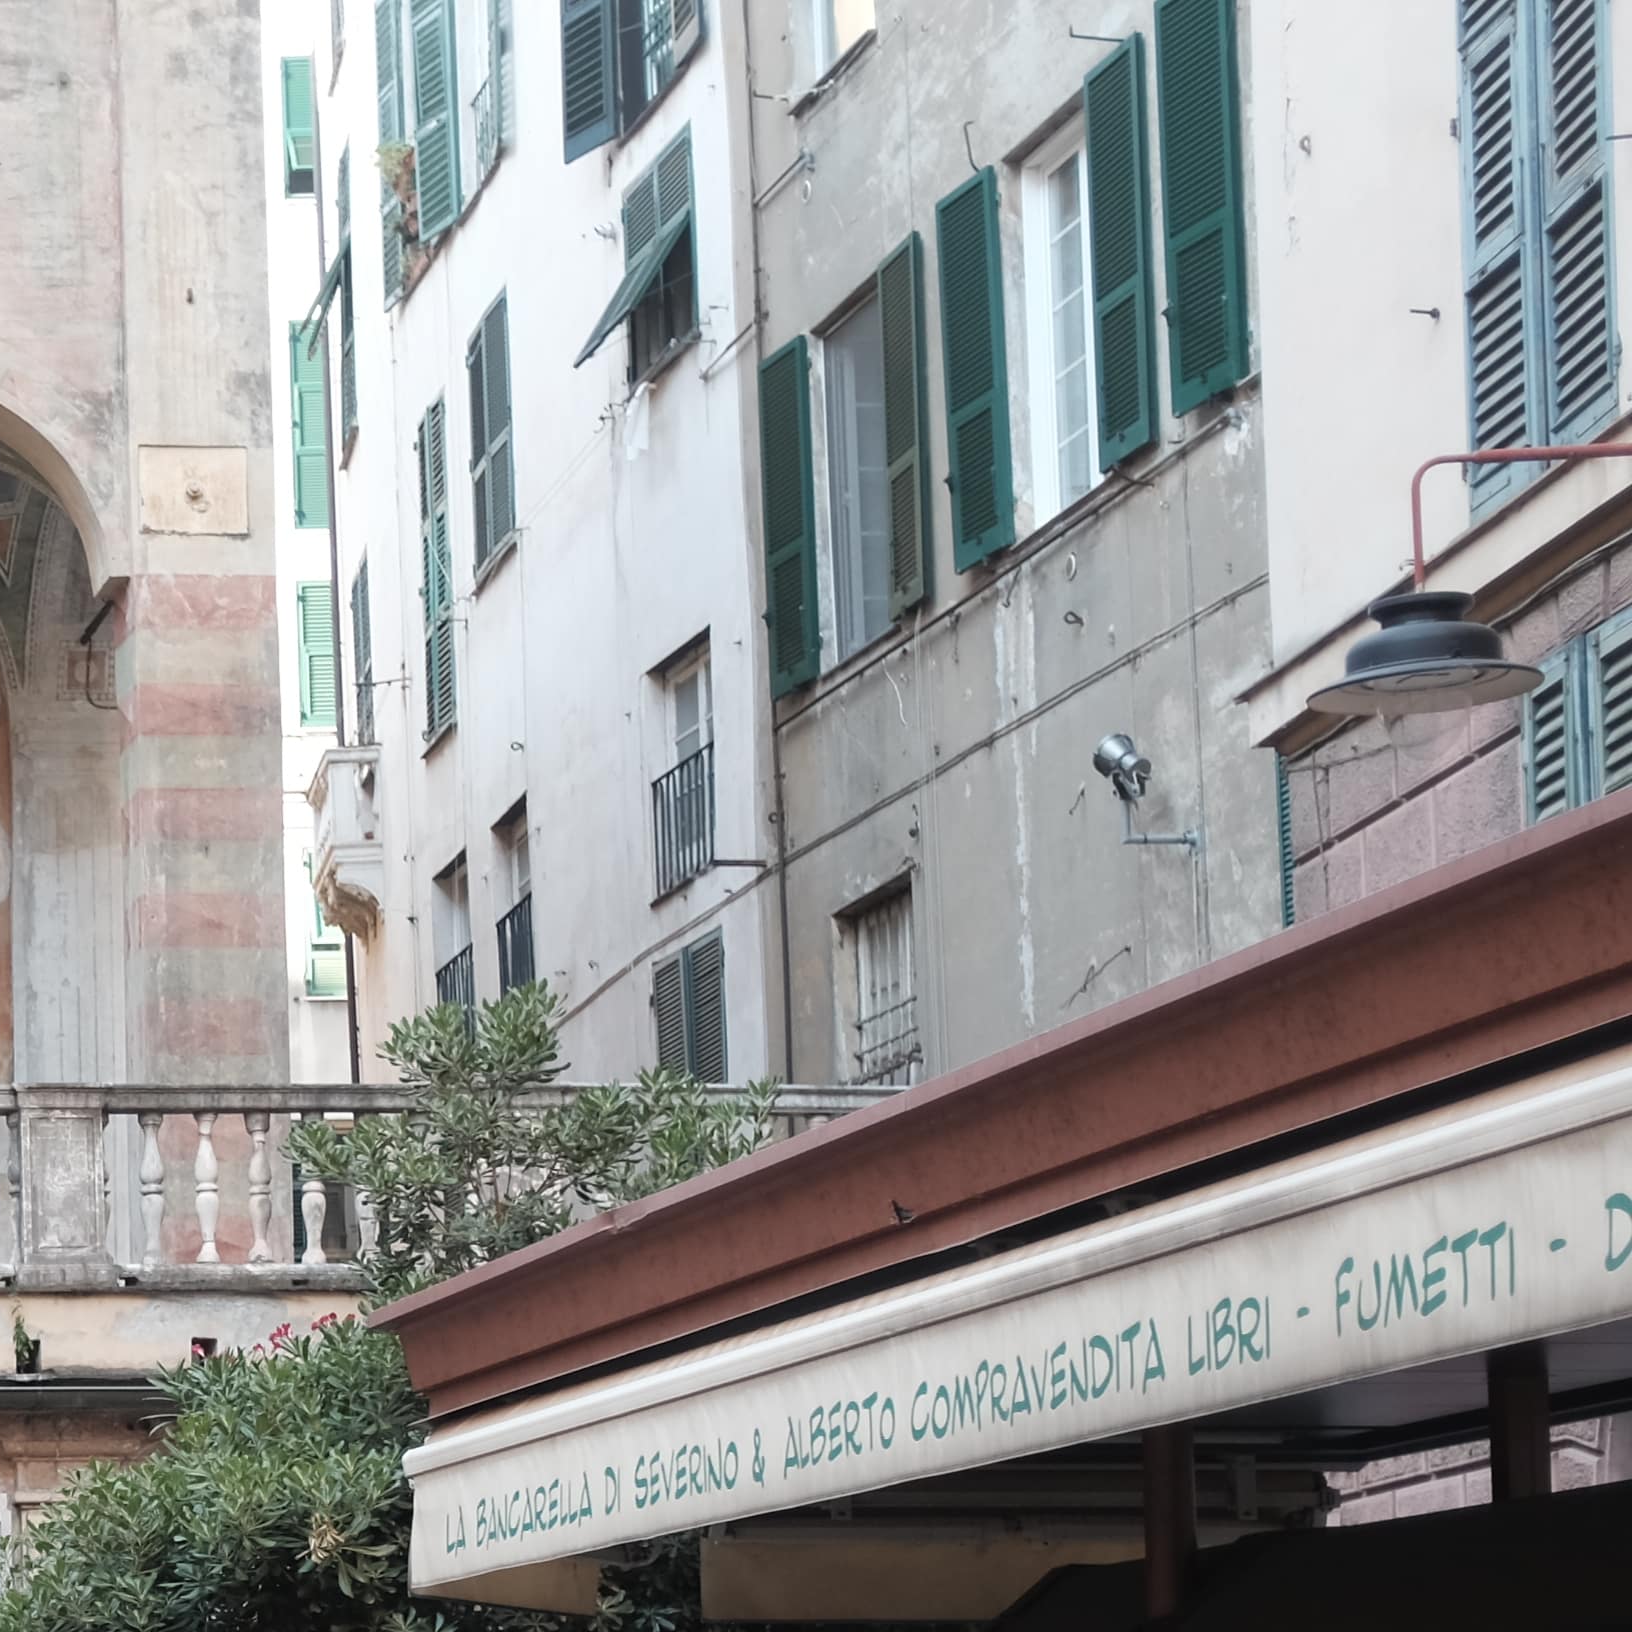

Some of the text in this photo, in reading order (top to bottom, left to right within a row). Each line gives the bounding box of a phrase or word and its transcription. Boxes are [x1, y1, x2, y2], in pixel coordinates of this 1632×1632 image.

[445, 1506, 467, 1554] LA
[476, 1471, 593, 1546] BANCARELLA
[603, 1465, 622, 1515] DI
[634, 1440, 739, 1510] SEVERINO
[752, 1427, 766, 1485] &
[784, 1391, 896, 1480] ALBERTO
[910, 1317, 1167, 1442] COMPRAVENDITA
[1187, 1296, 1271, 1377] LIBRI
[1336, 1221, 1516, 1338] FUMETTI
